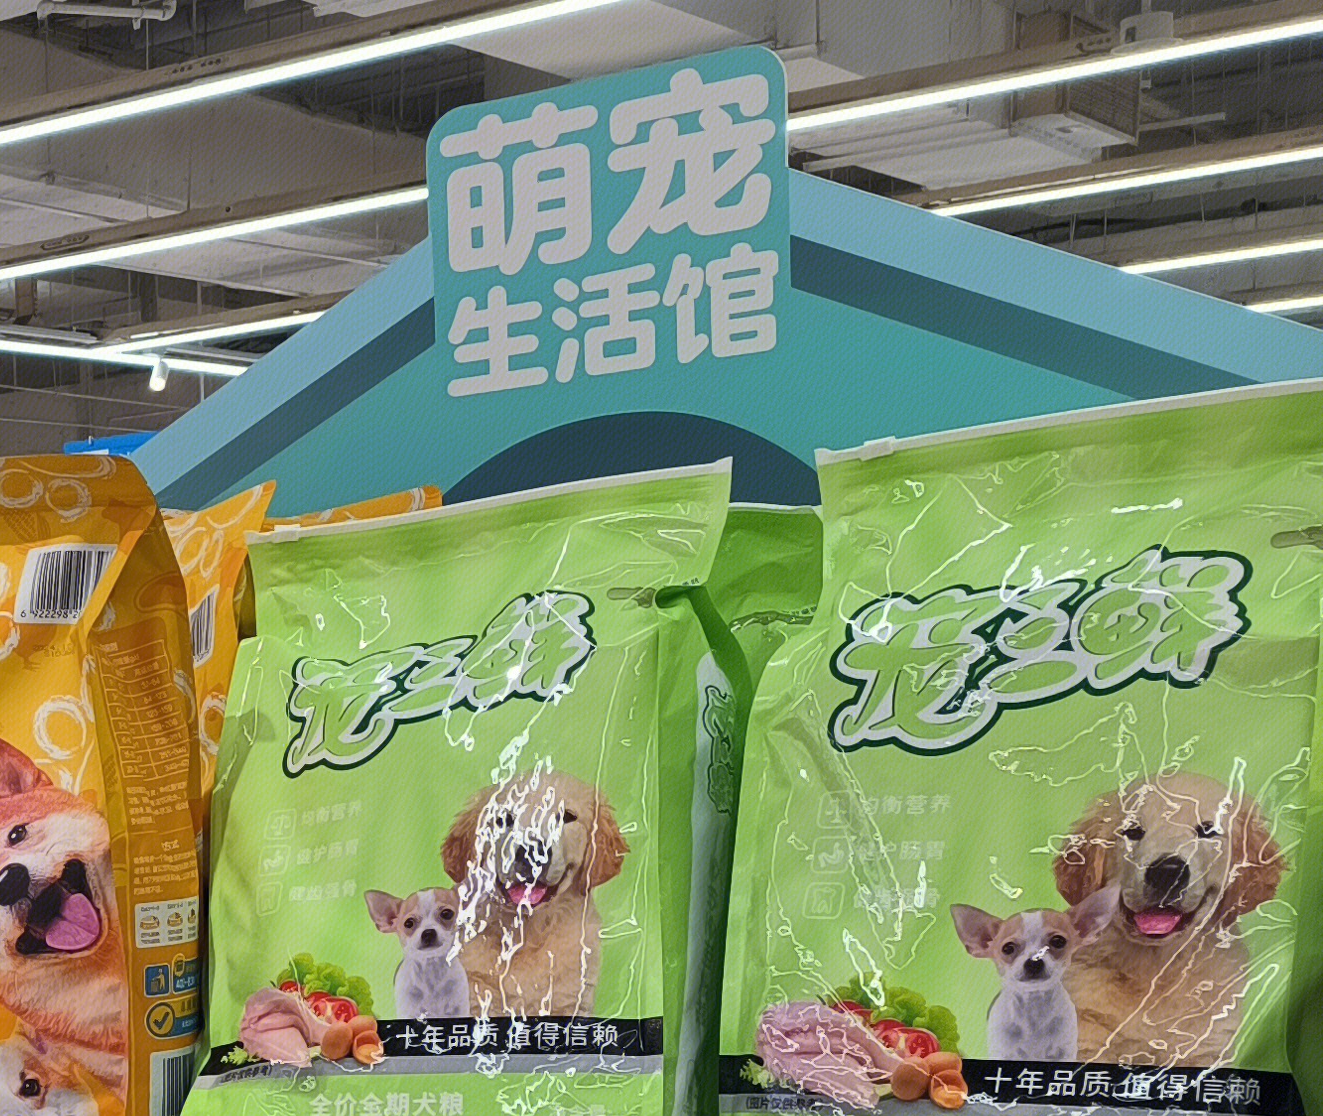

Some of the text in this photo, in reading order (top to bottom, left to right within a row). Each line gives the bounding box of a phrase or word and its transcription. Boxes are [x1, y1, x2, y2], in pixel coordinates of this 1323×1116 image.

[440, 68, 776, 276] 萌宠
[447, 243, 779, 397] 生活馆
[396, 1022, 619, 1050] 十年品质 值得信赖
[983, 1066, 1263, 1108] 十年品质 值得信赖
